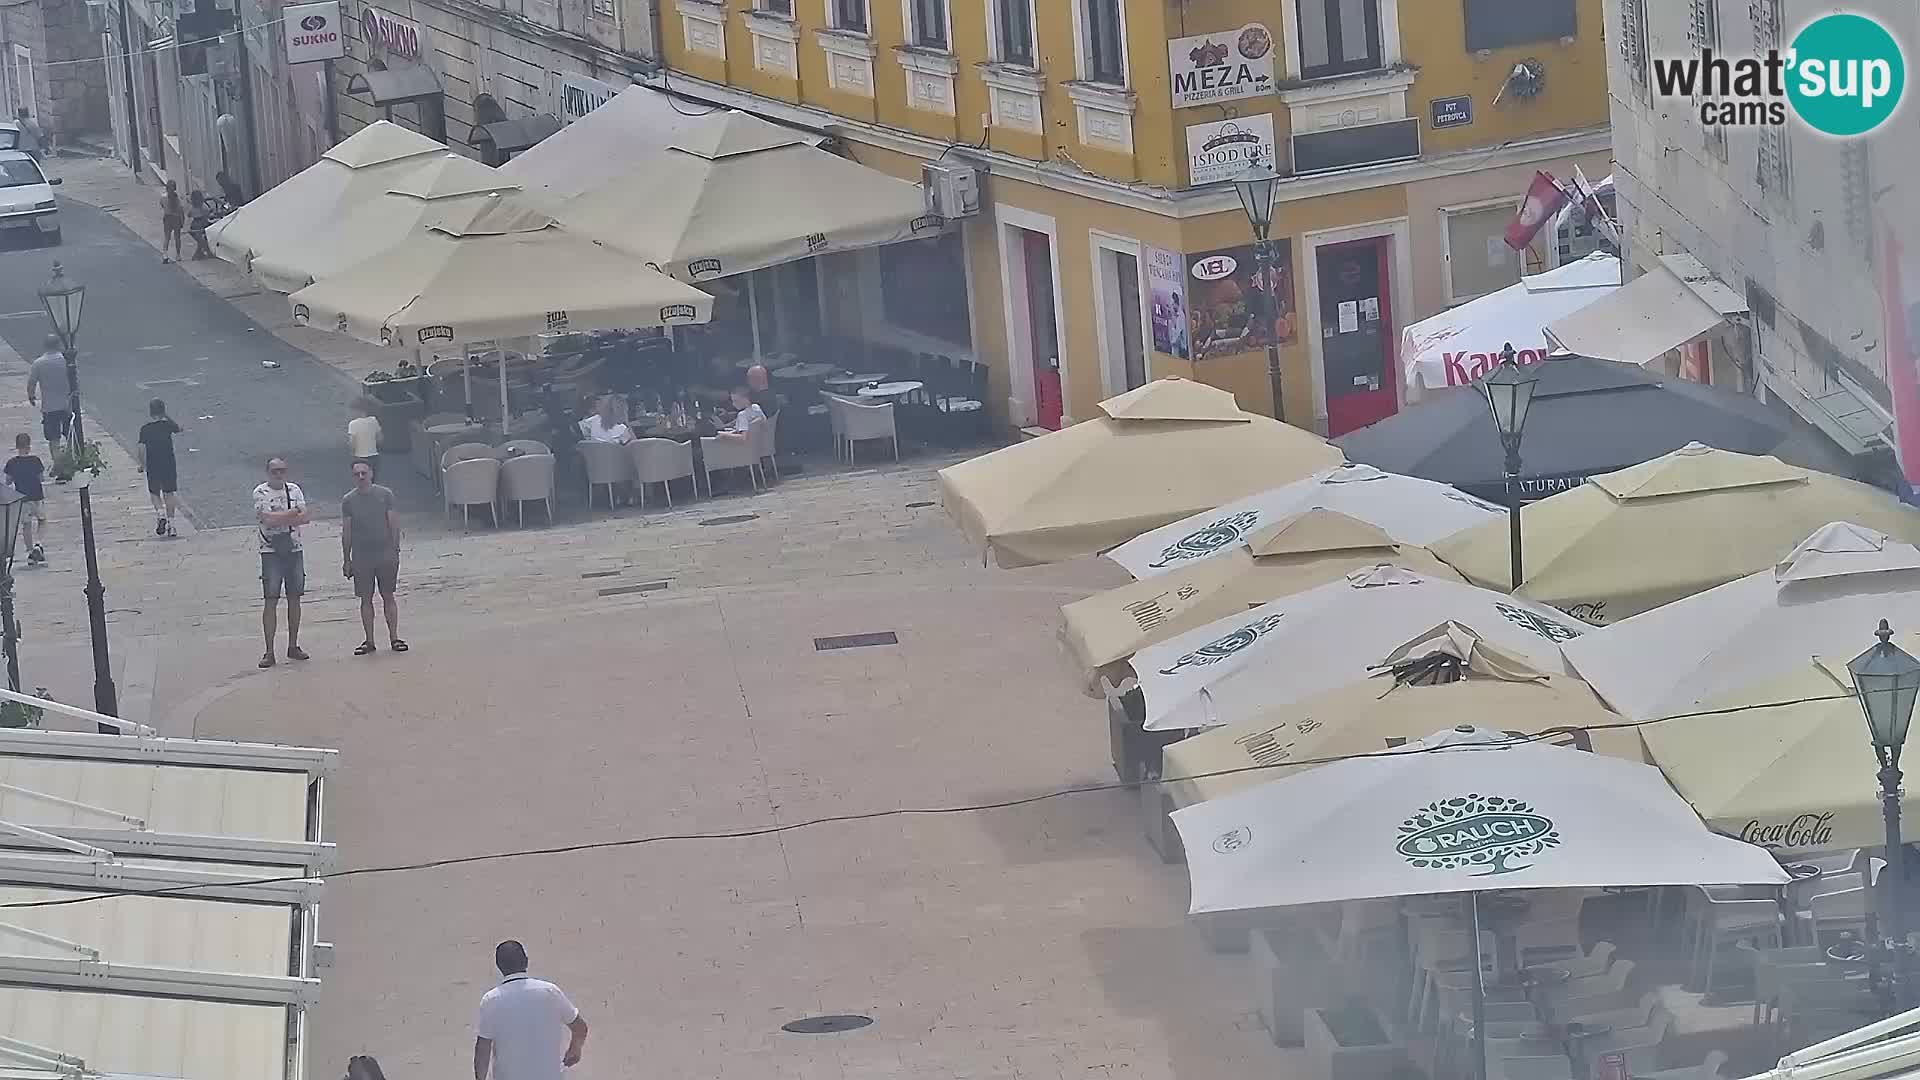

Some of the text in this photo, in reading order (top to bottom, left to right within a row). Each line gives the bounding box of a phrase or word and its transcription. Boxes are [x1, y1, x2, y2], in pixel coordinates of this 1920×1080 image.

[292, 32, 337, 46] SUKNO
[379, 16, 418, 57] SUKNO
[1175, 64, 1253, 94] MEZA
[1184, 85, 1244, 101] PIZZERIA & GRILL
[1437, 111, 1467, 123] PETROVCA
[1445, 102, 1457, 112] PUT
[1193, 149, 1239, 168] ISPOD
[1243, 143, 1272, 160] URE
[1437, 818, 1535, 849] RAUCH
